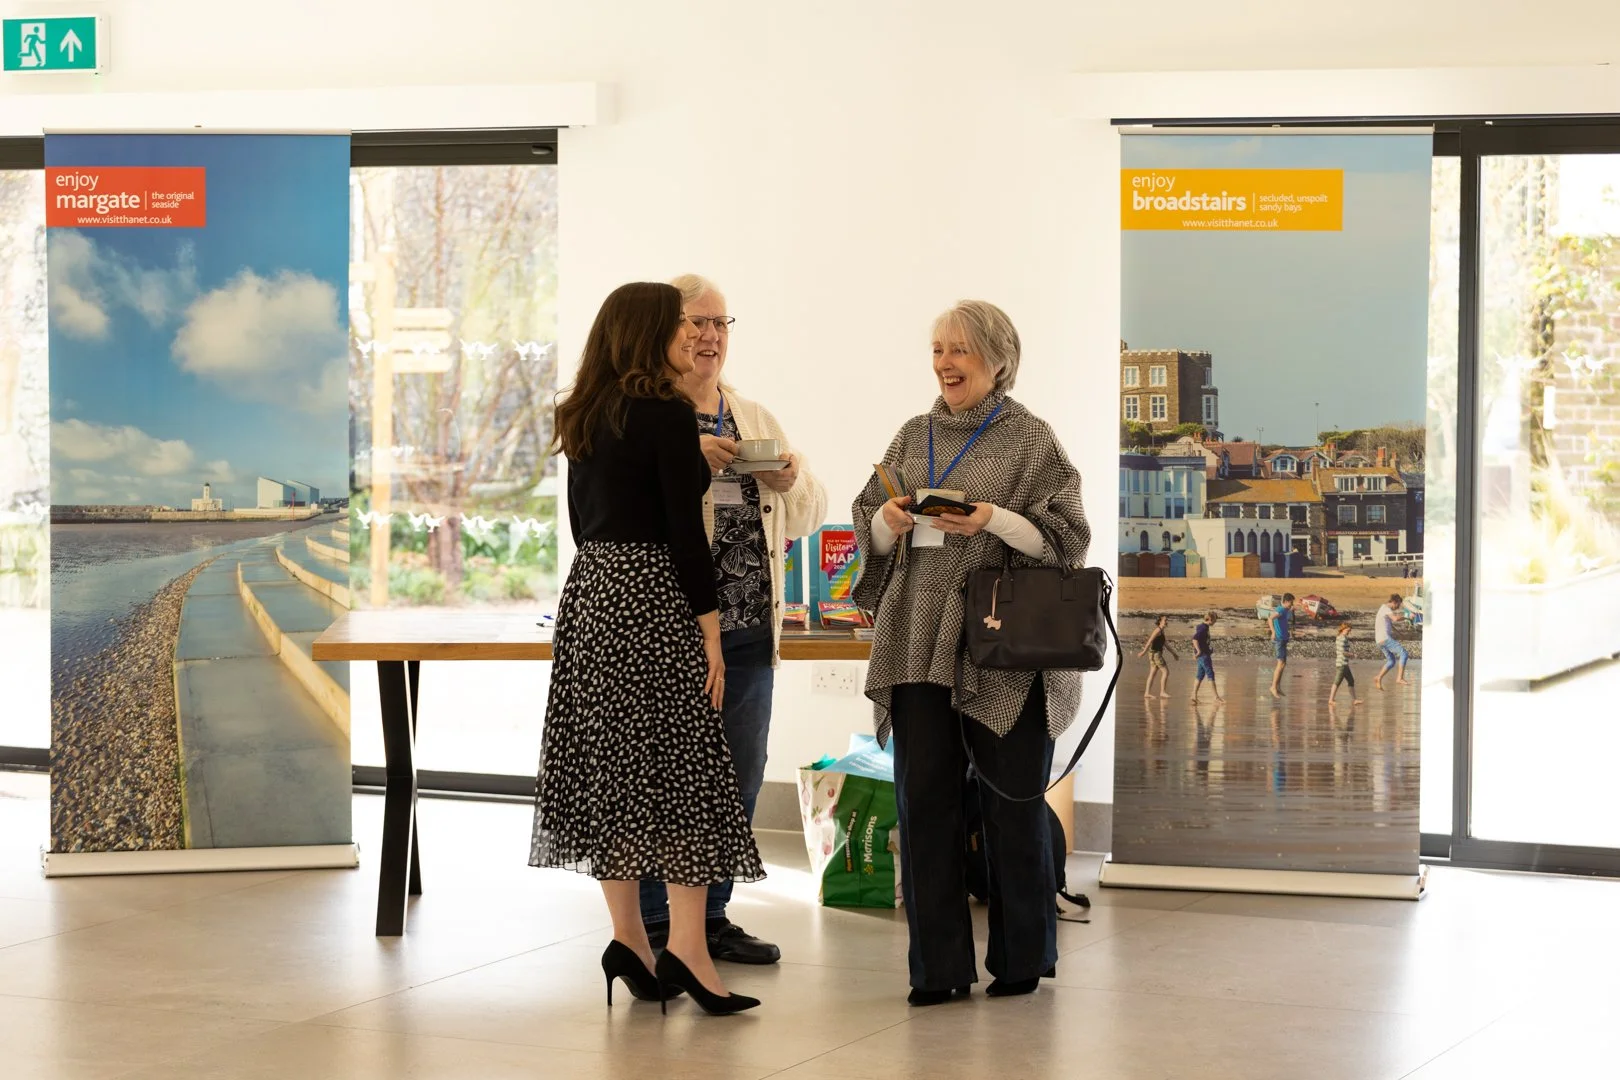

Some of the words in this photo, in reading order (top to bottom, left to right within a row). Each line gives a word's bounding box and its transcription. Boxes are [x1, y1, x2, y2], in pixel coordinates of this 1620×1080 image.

[55, 171, 99, 191] enjoy
[1132, 172, 1175, 191] enjoy
[151, 191, 165, 200] the
[166, 191, 195, 202] original
[1132, 190, 1246, 211] broadstairs
[1259, 194, 1295, 203] secluded,
[1297, 194, 1328, 204] unspoilt
[56, 191, 140, 214] margate
[151, 200, 180, 209] seaside
[1259, 203, 1283, 213] sandy
[1284, 203, 1302, 213] bays
[77, 214, 172, 224] www.visitthanet.co.uk
[1182, 218, 1278, 228] www.visitthanet.co.uk
[825, 553, 855, 564] MAP
[847, 818, 856, 831] shop
[861, 815, 877, 863] Morrisons
